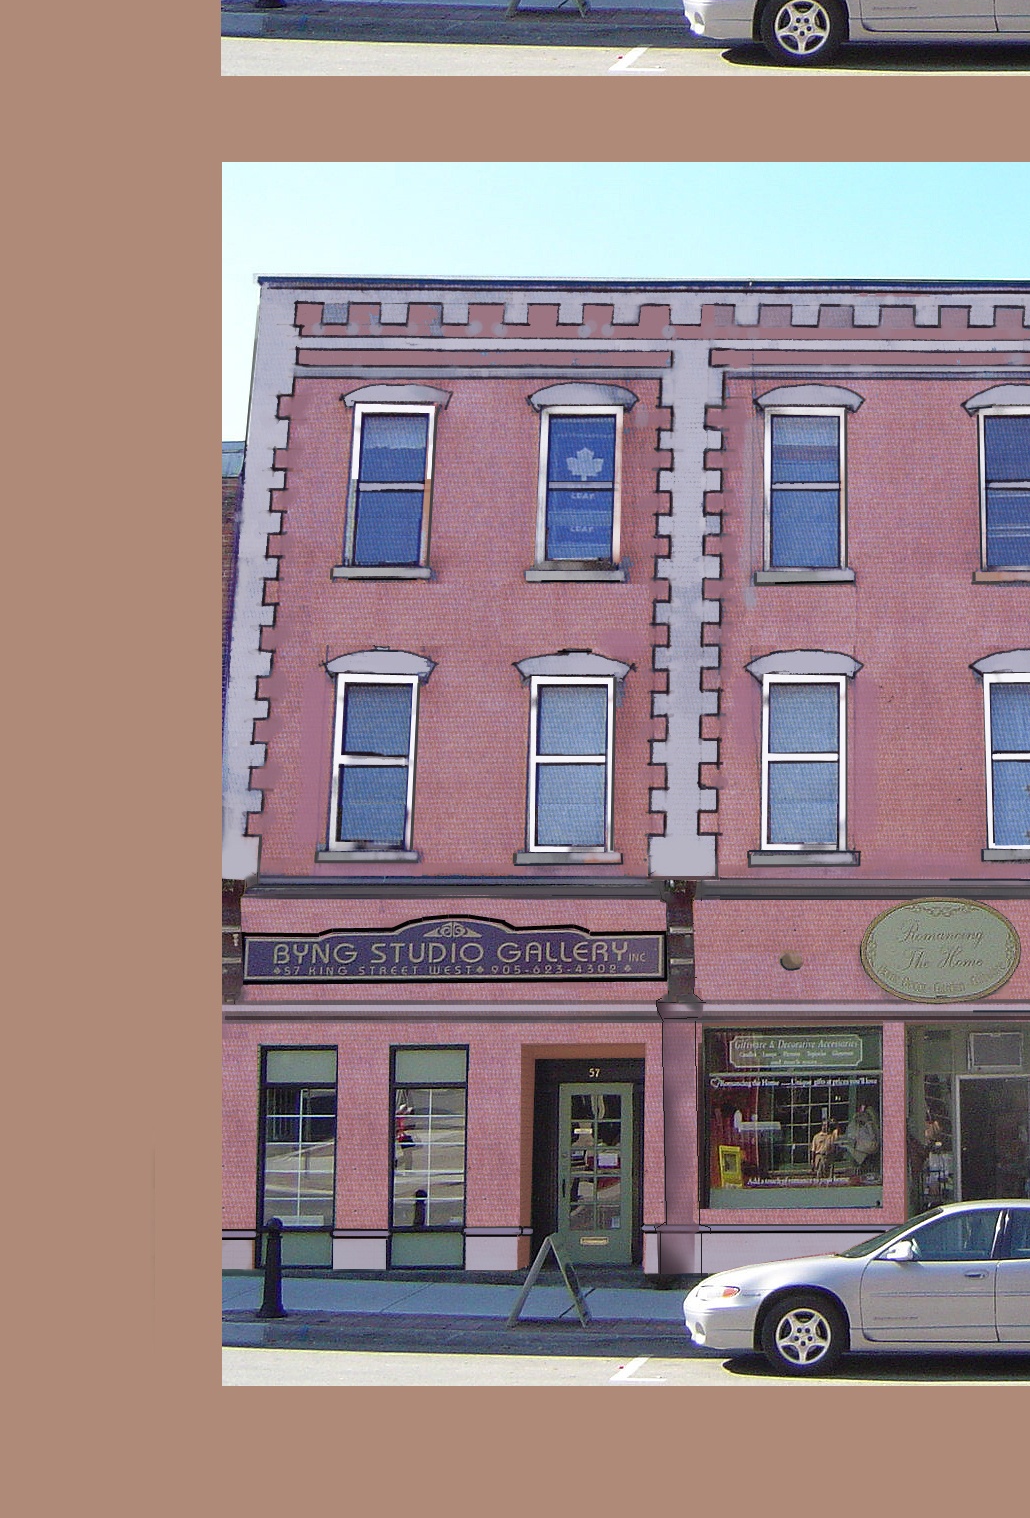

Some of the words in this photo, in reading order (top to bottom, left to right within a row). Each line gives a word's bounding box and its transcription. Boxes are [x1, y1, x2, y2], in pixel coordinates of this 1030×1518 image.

[899, 919, 983, 947] Romancing
[273, 944, 358, 964] BYNG
[370, 943, 484, 963] STUDIO
[497, 942, 628, 962] GALLERY
[901, 947, 929, 971] The
[937, 946, 983, 969] Home
[285, 966, 300, 975] 57
[308, 966, 348, 975] KING
[358, 966, 418, 975] STREET
[428, 966, 471, 974] WEST
[492, 965, 616, 974] 905-623-4302
[778, 1040, 816, 1050] Decorative
[589, 1068, 600, 1078] 57
